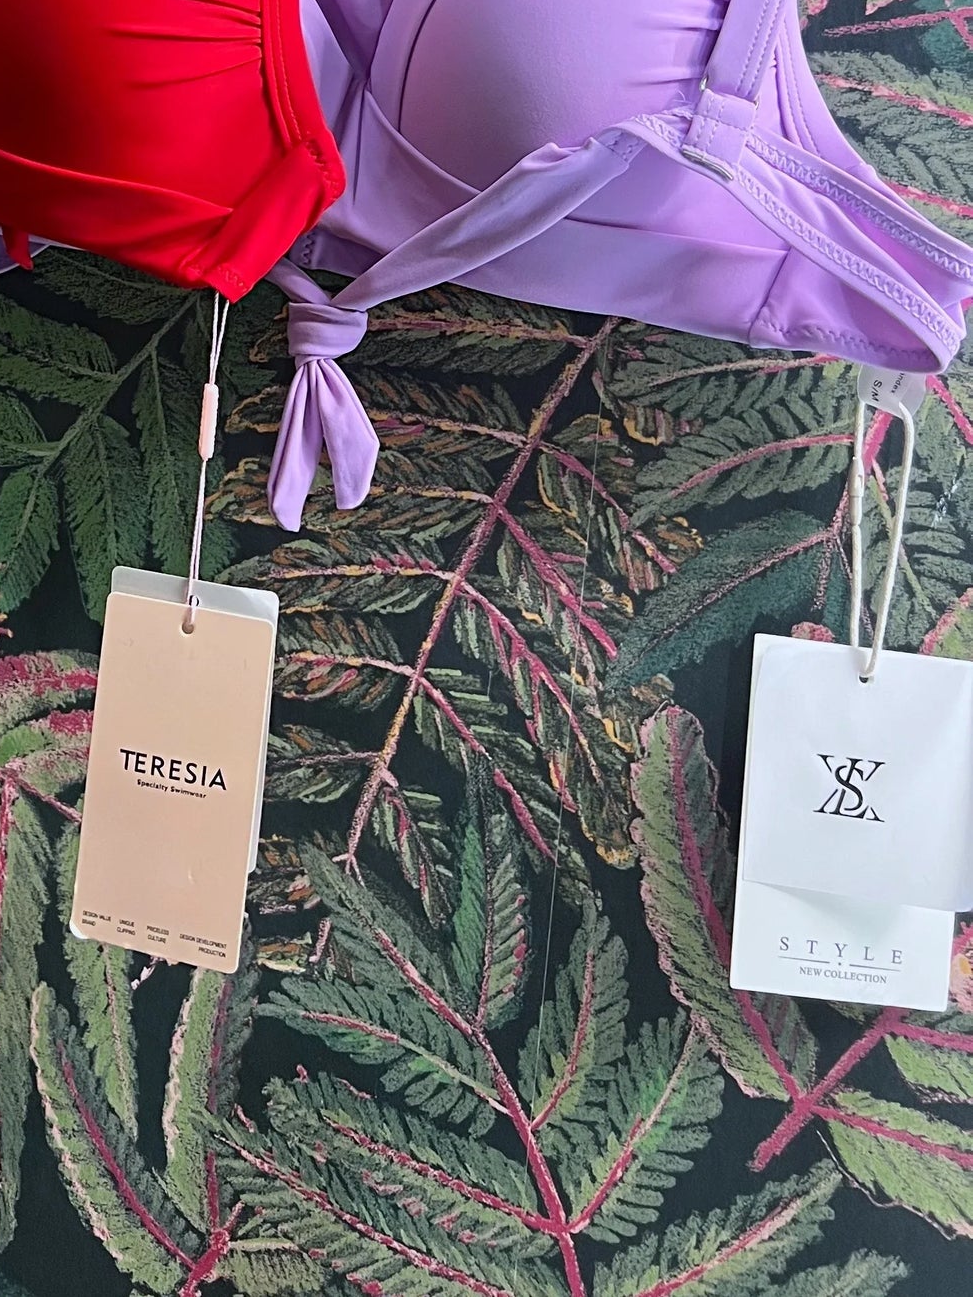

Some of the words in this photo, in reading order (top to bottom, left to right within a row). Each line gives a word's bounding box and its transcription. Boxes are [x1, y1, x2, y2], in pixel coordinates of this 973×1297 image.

[871, 379, 883, 403] S/M
[119, 748, 227, 791] TERESIA
[779, 936, 903, 965] STYLE
[799, 966, 822, 977] NEW
[823, 969, 887, 984] COLLECTION
